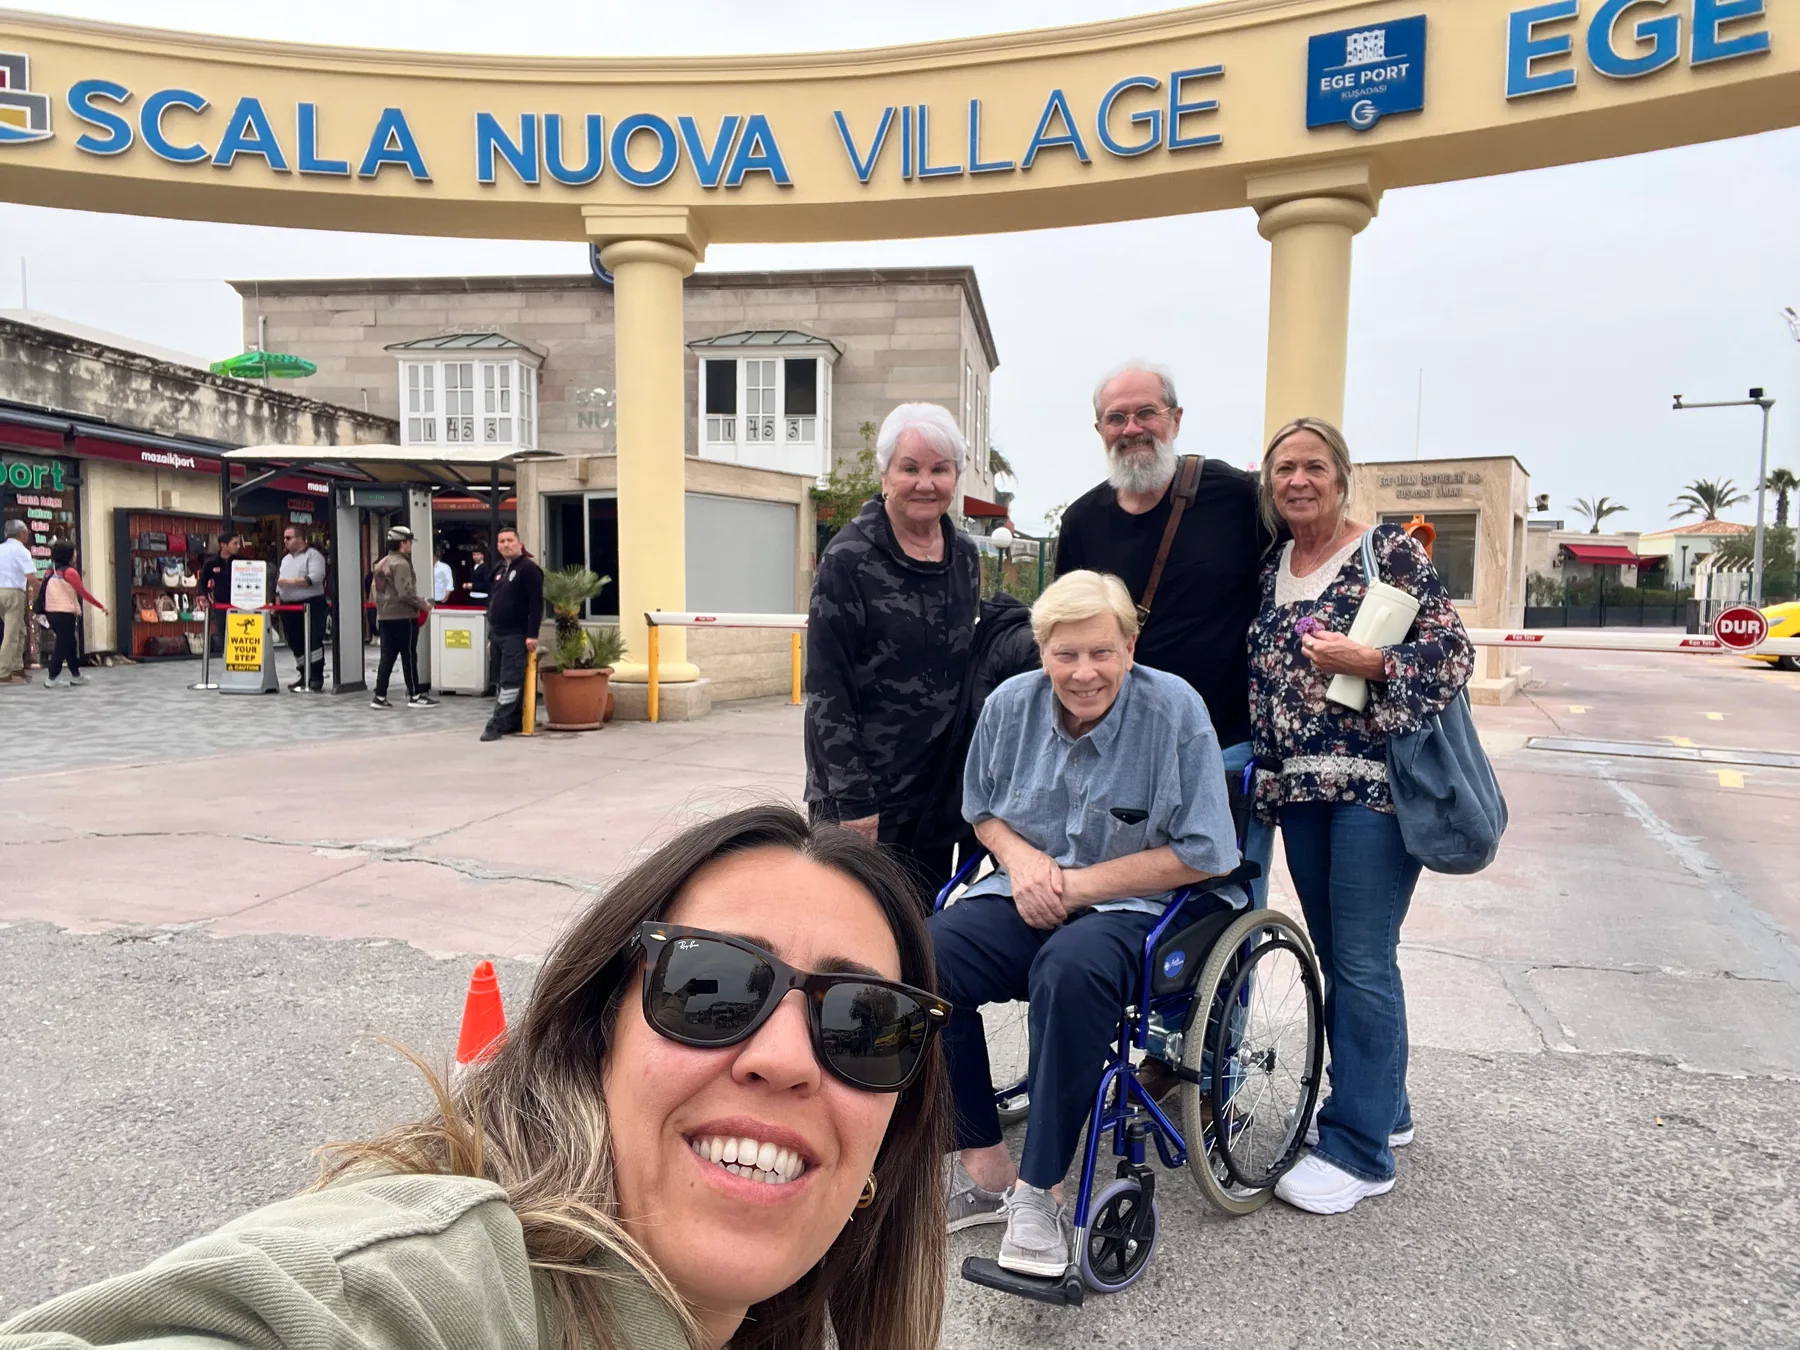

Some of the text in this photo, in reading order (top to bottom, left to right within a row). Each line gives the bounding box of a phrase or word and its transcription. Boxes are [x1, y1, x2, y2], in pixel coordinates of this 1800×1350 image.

[1505, 0, 1771, 100] EGE
[1321, 63, 1410, 91] EGE PORT
[66, 64, 1226, 188] SCALA NUOVA VILLAGE
[1721, 620, 1760, 634] DUR
[231, 637, 260, 645] WATCH
[234, 646, 257, 654] YOUR
[234, 654, 256, 662] STEP
